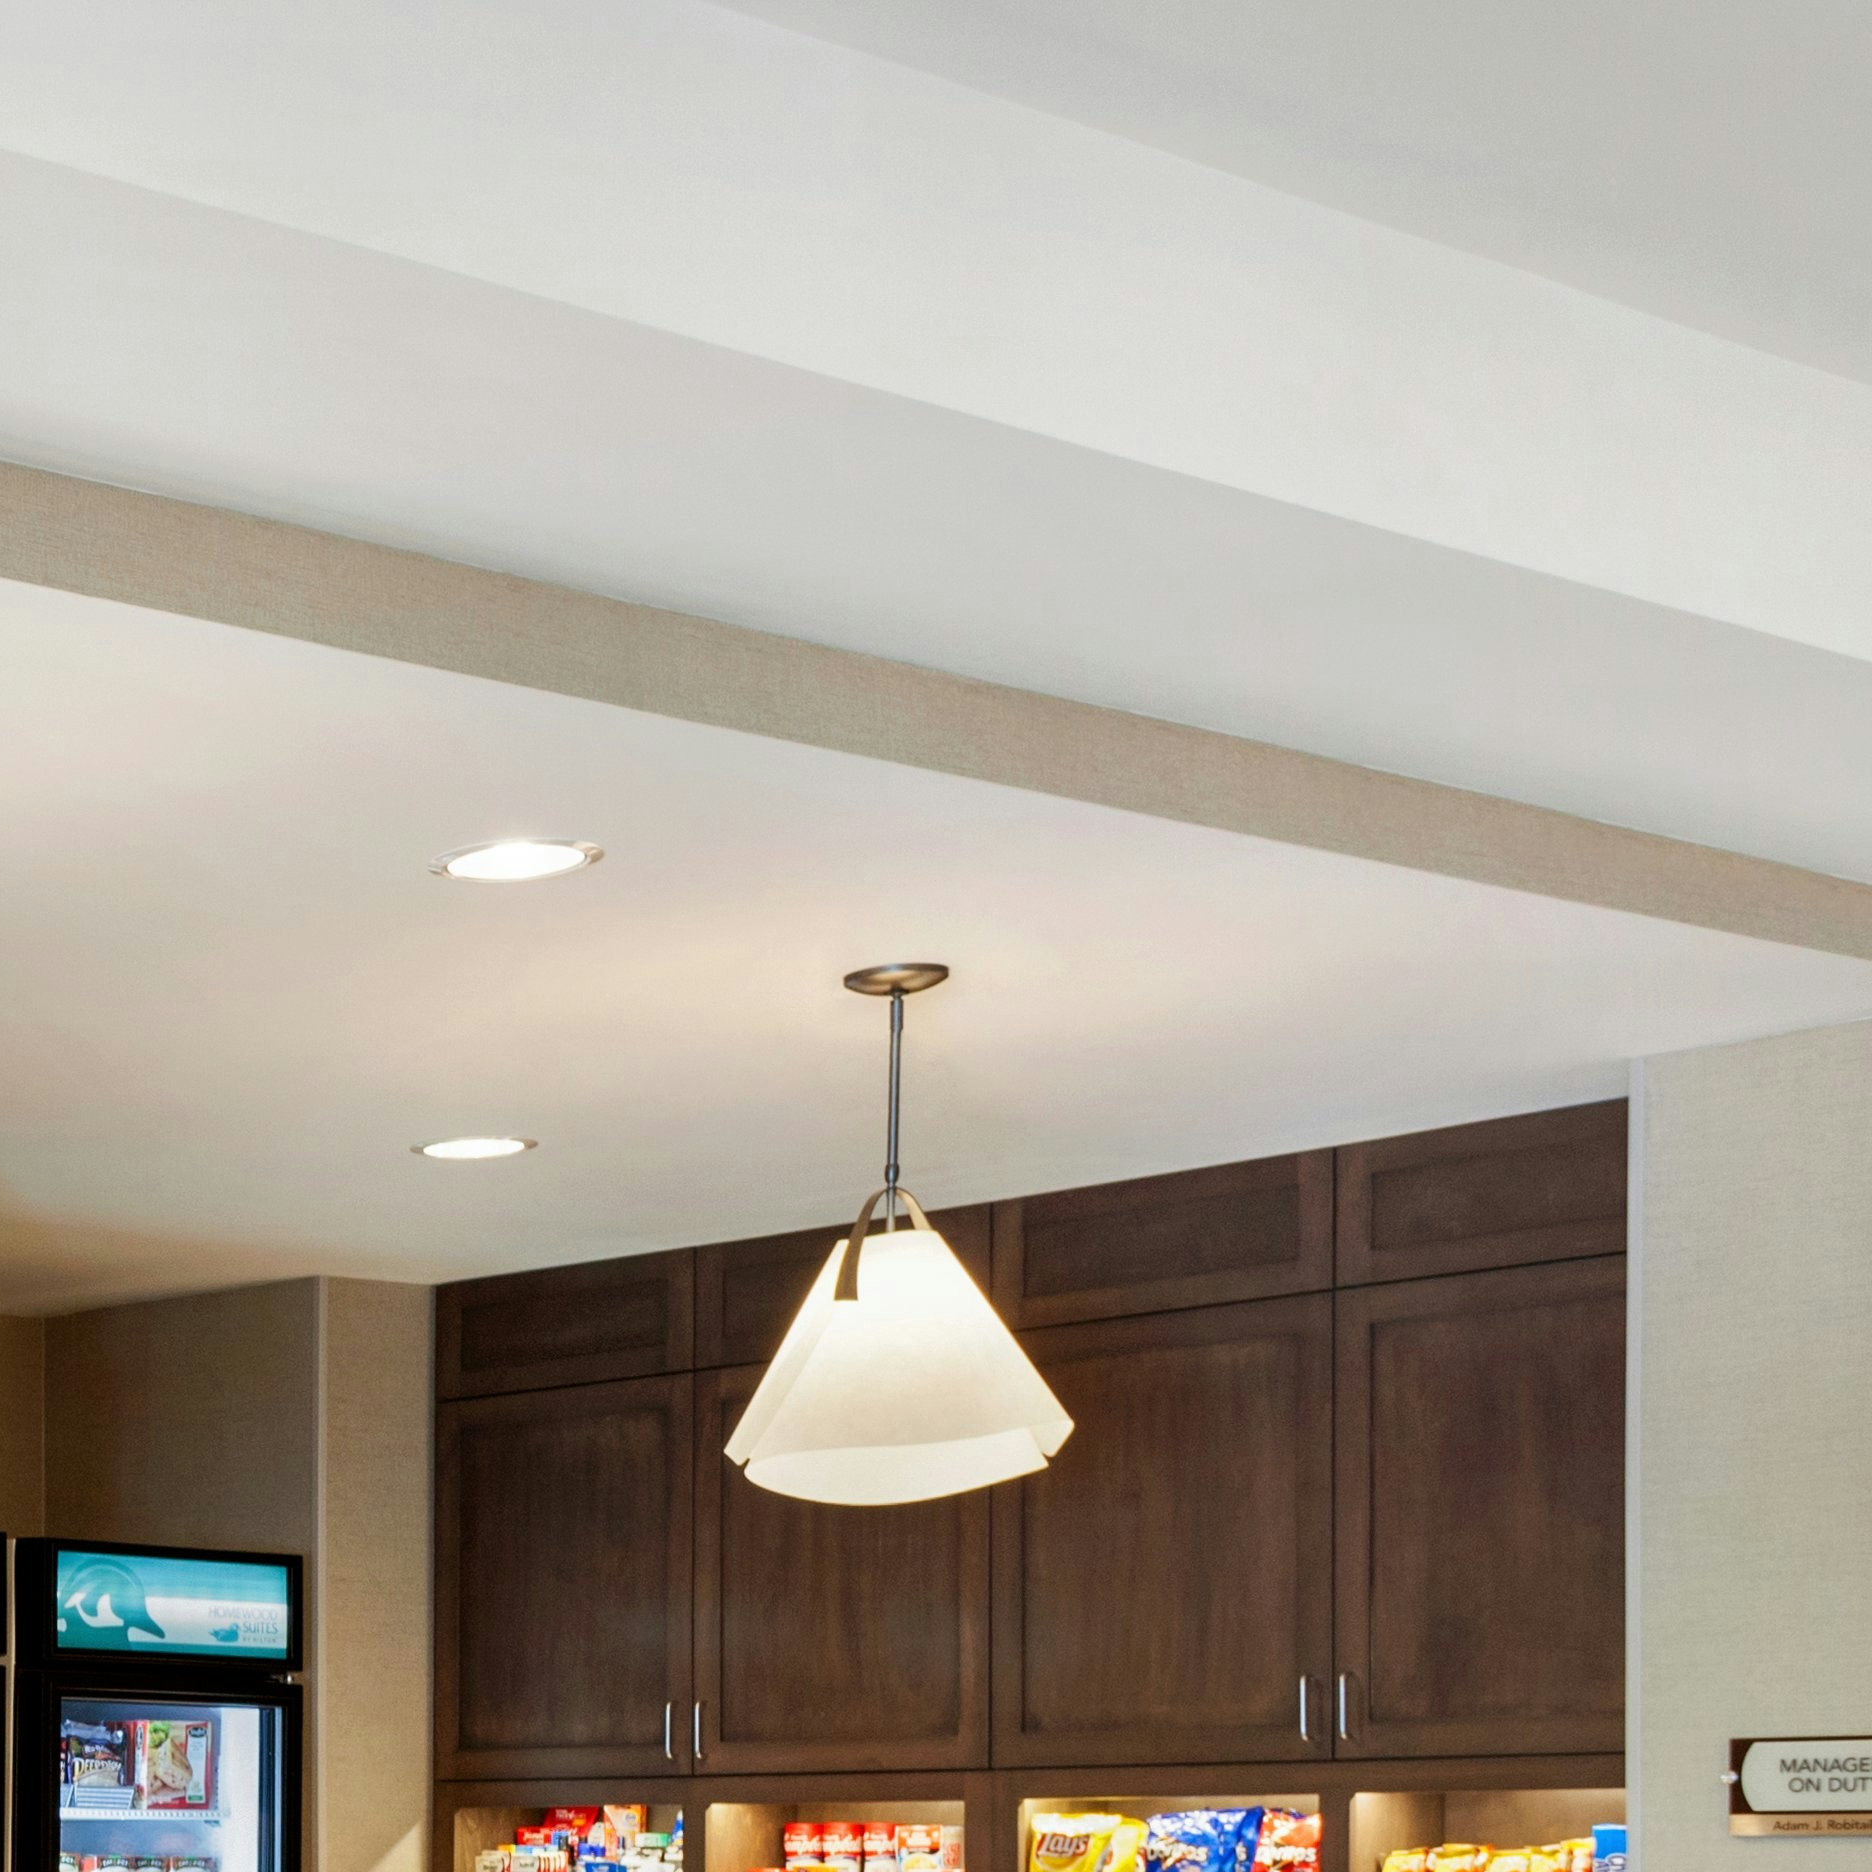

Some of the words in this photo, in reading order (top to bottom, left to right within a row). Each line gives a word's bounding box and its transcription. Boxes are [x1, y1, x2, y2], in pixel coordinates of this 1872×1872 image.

[242, 1621, 278, 1634] SUITES
[1779, 1757, 1872, 1773] MANAGE
[1788, 1777, 1820, 1793] ON
[1828, 1776, 1872, 1792] DUT
[1773, 1821, 1809, 1831] Adam
